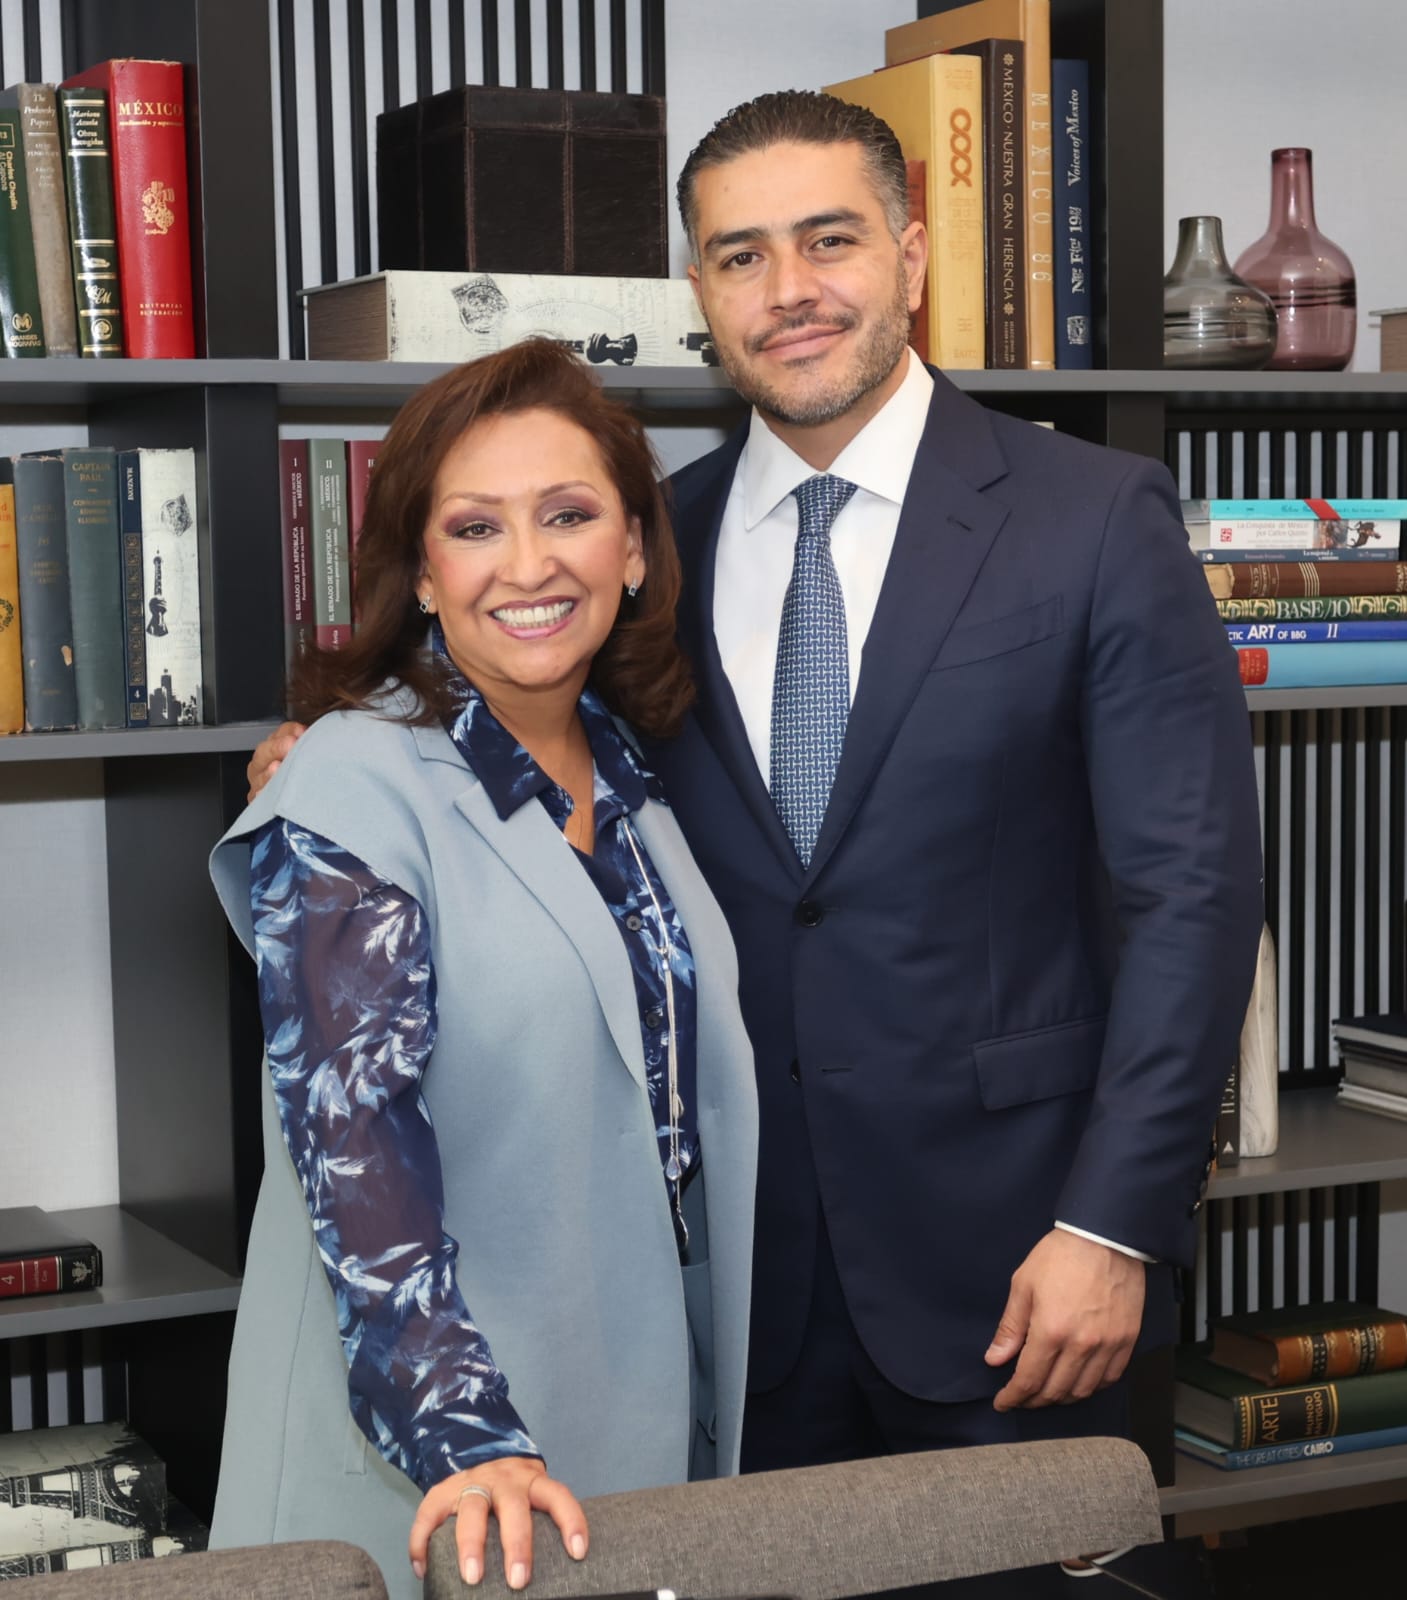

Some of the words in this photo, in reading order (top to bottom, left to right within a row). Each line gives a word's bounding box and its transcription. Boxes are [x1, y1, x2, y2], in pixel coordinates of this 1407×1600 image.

[1003, 68, 1014, 124] MEXICO
[69, 109, 100, 118] Mariano
[119, 99, 182, 116] MÉXICO
[1066, 89, 1081, 134] Mexico
[77, 129, 98, 138] Obras
[6, 151, 15, 180] Charles
[1003, 131, 1014, 187] NUESTRA
[1067, 148, 1081, 187] Voices
[9, 180, 17, 211] Chaplin
[1003, 192, 1014, 230] GRAN
[1003, 238, 1015, 300] HERENCIA
[72, 462, 111, 471] CAPTAIN
[127, 467, 135, 500] MANZONI
[293, 564, 300, 572] LA
[327, 565, 333, 574] LA
[294, 574, 300, 583] DE
[328, 576, 333, 584] DE
[296, 612, 301, 620] EL
[329, 613, 334, 621] EL
[1276, 600, 1350, 619] BASE/10
[1229, 632, 1243, 640] CTIC
[1247, 624, 1276, 640] ART
[1278, 630, 1288, 639] OF
[1, 1275, 15, 1285] 4
[1260, 1397, 1279, 1441] ARTE
[1303, 1441, 1334, 1456] CAIRO
